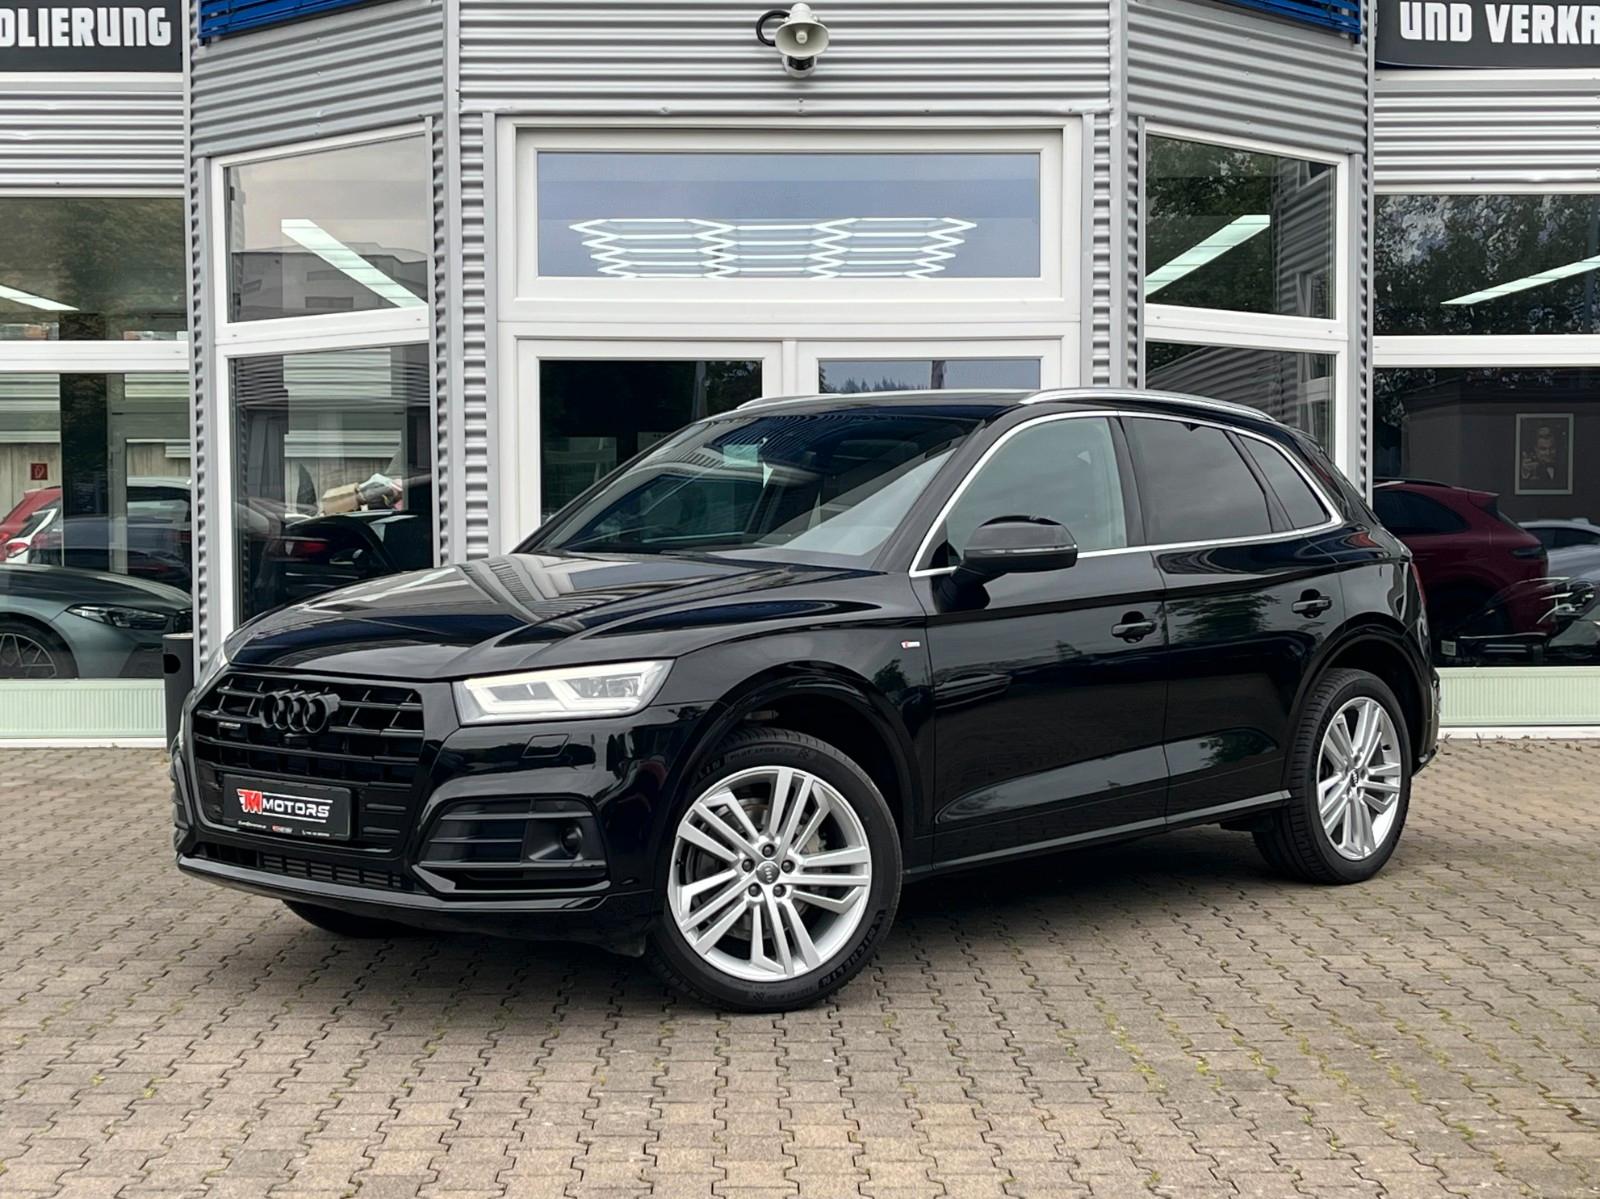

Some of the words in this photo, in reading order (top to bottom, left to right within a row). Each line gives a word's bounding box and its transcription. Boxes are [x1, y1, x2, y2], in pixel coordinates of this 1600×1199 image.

[1400, 2, 1472, 42] UND
[1485, 3, 1600, 45] VERKA
[262, 798, 331, 818] MOTORS
[822, 927, 877, 986] MICHELIN
